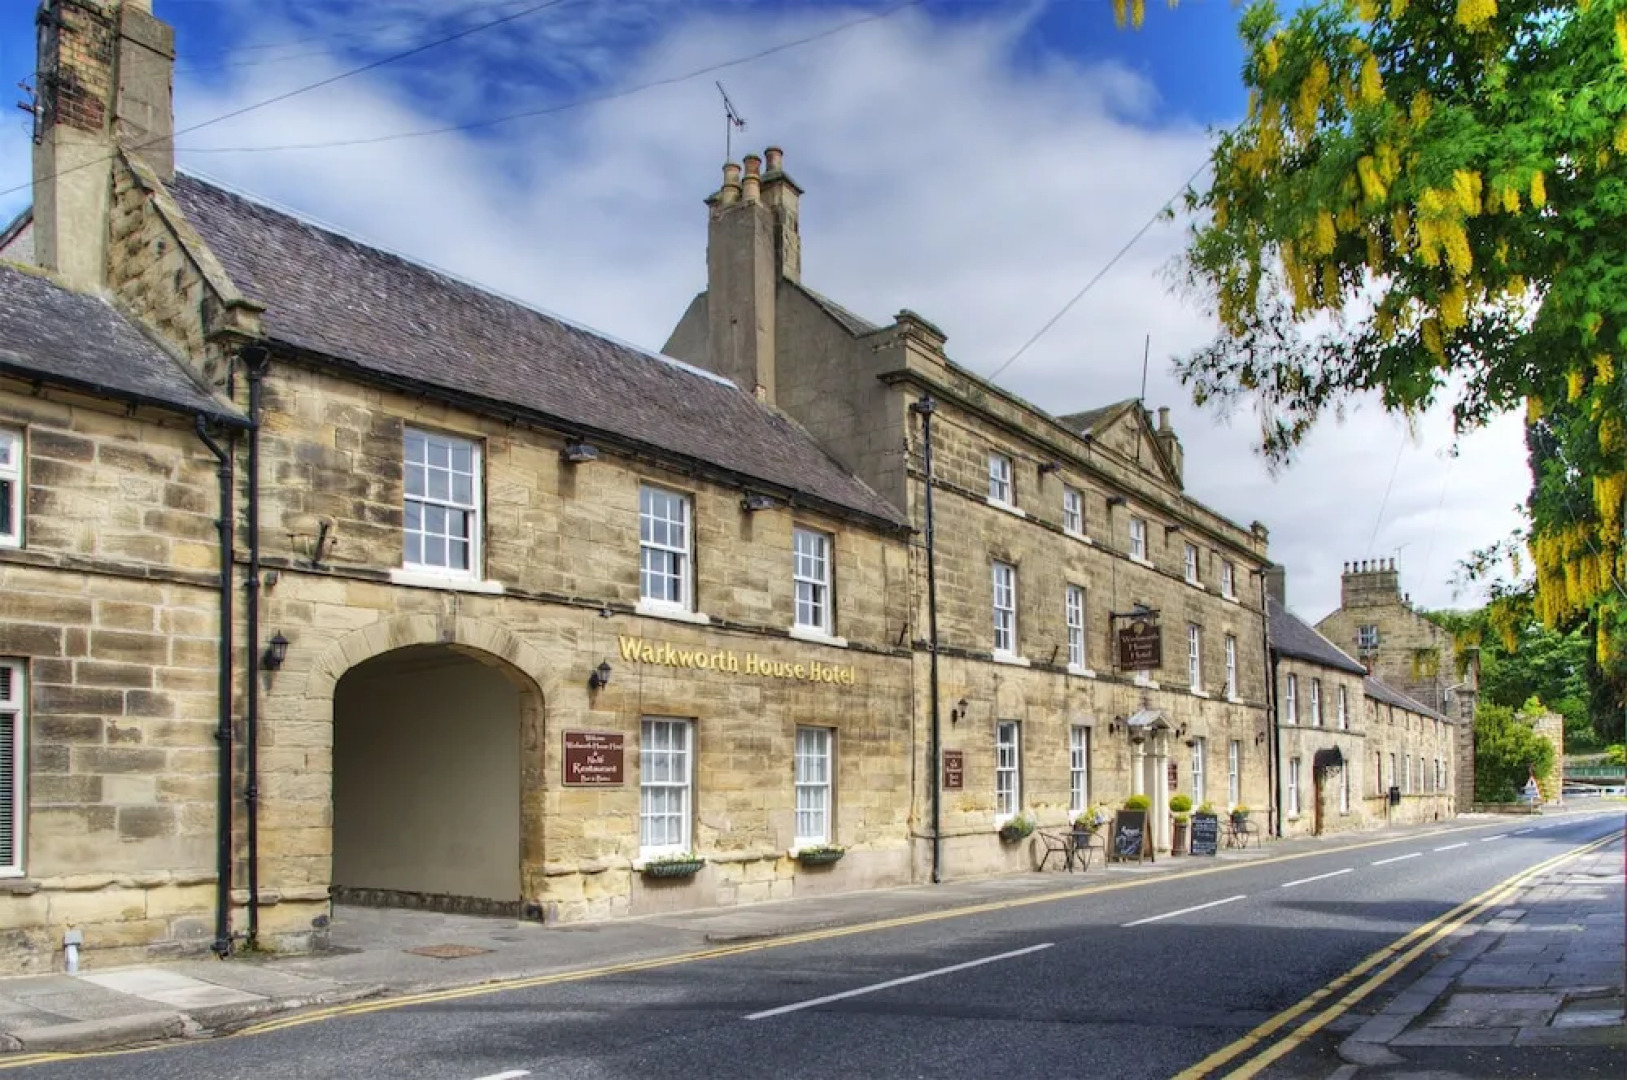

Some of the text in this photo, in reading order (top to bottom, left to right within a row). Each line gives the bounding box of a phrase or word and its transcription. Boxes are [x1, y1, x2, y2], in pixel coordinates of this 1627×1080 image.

[619, 635, 855, 684] Warkworth House Hotel
